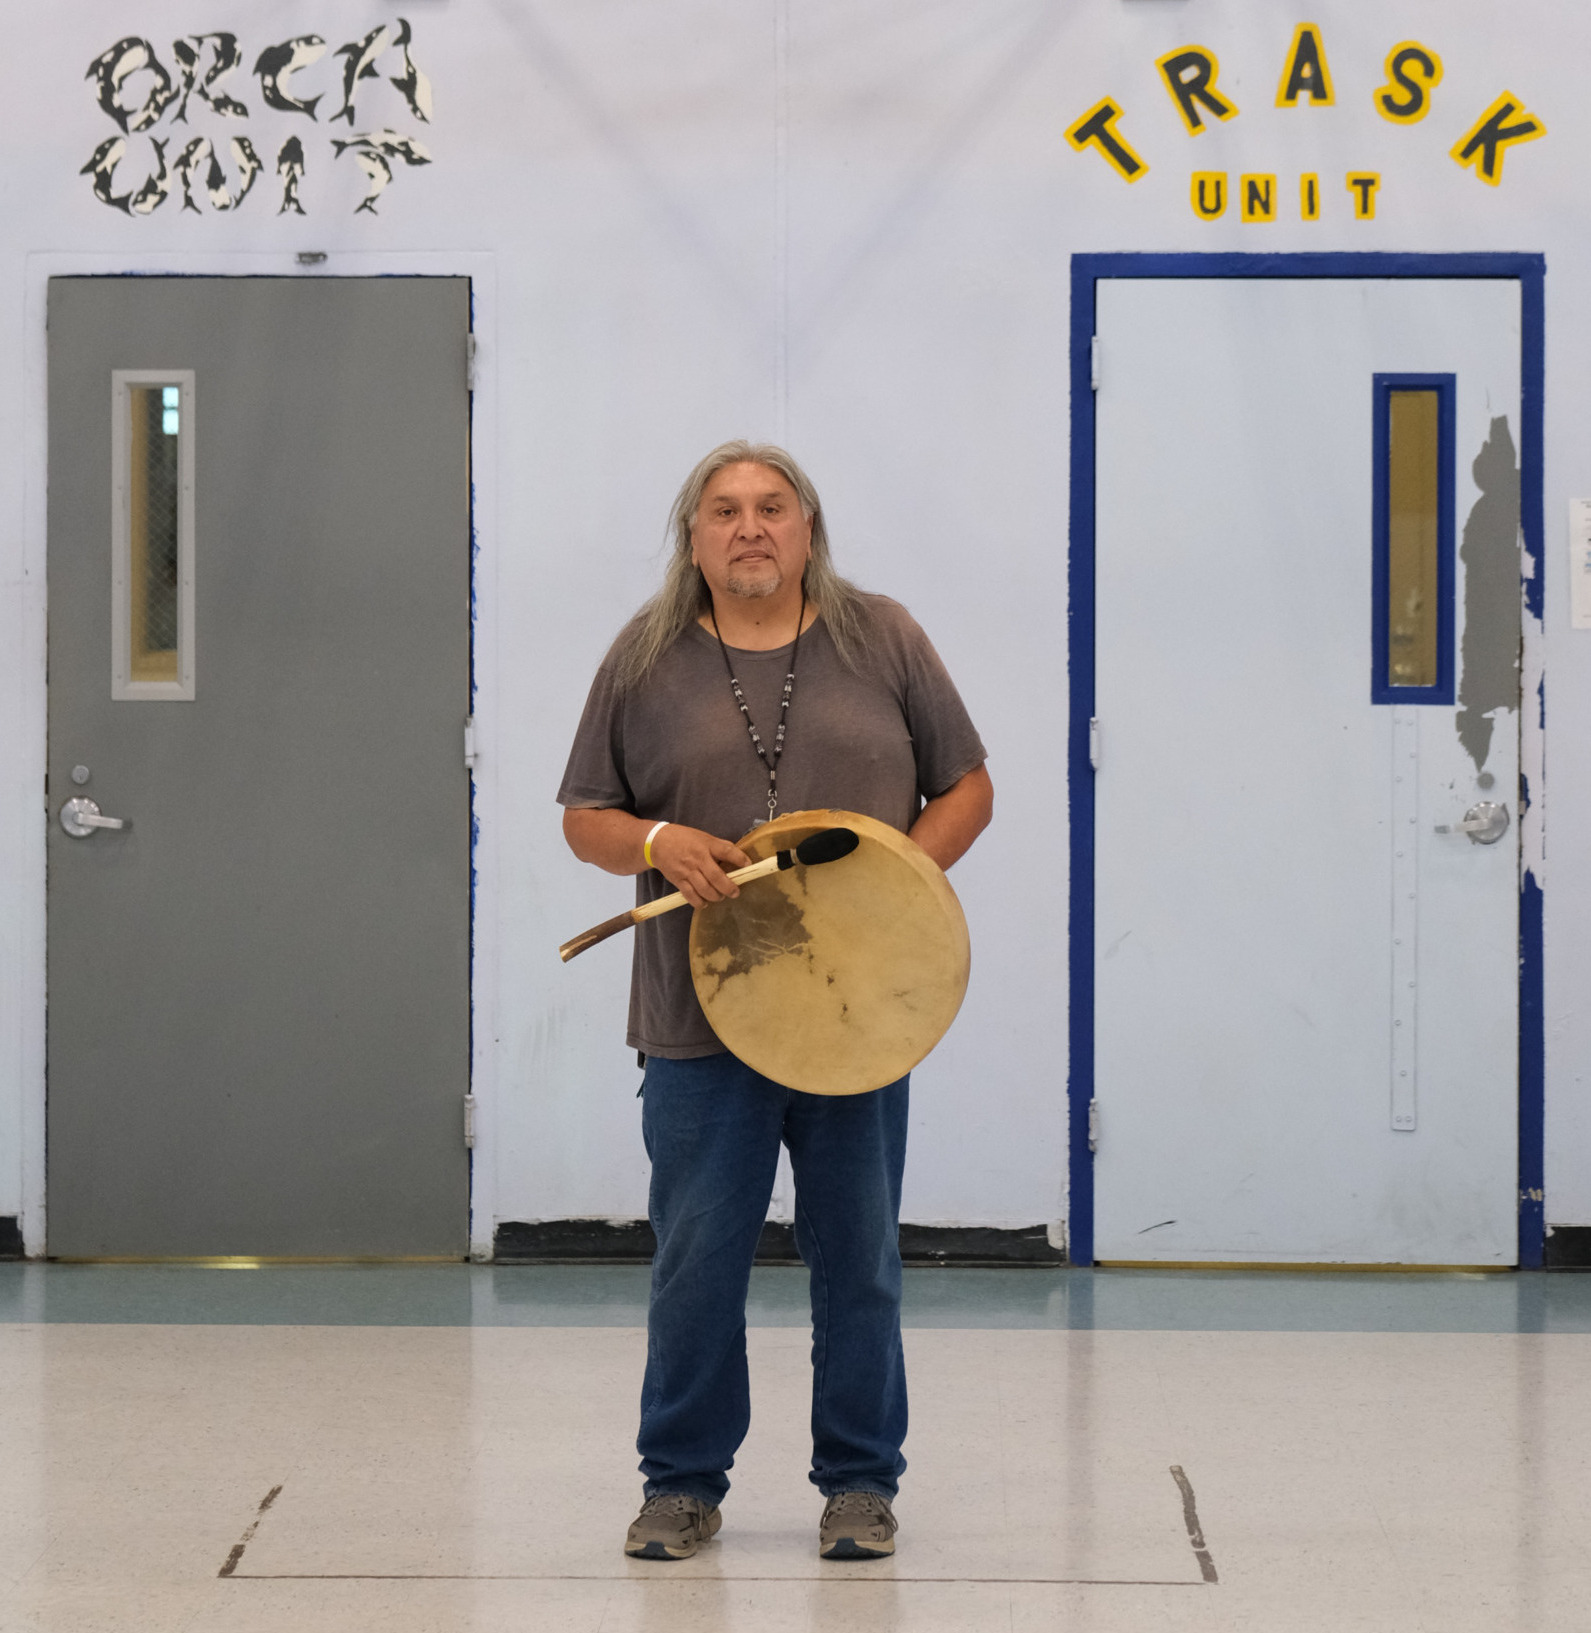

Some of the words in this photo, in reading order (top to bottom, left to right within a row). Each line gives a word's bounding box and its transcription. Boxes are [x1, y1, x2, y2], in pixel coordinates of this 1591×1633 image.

[85, 18, 433, 135] ORCA
[1064, 22, 1548, 187] TRASK
[79, 129, 433, 217] UNIT
[1191, 171, 1381, 223] UNIT
